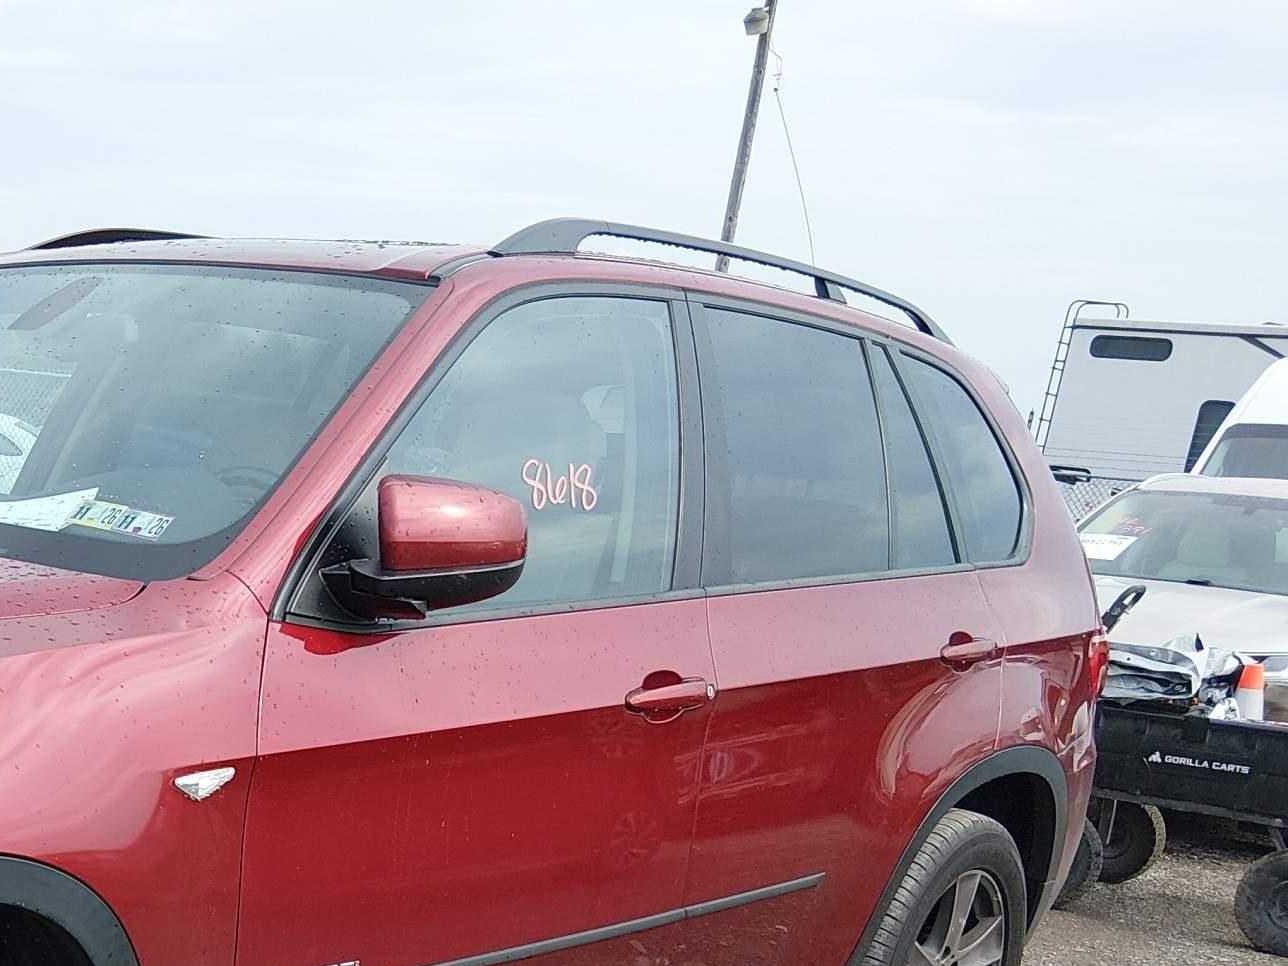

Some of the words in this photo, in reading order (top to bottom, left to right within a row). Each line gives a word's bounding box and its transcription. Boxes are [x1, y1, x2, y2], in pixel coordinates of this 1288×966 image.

[522, 458, 598, 511] 8618
[1164, 754, 1210, 769] GORILLA
[1212, 761, 1251, 774] CARTS
